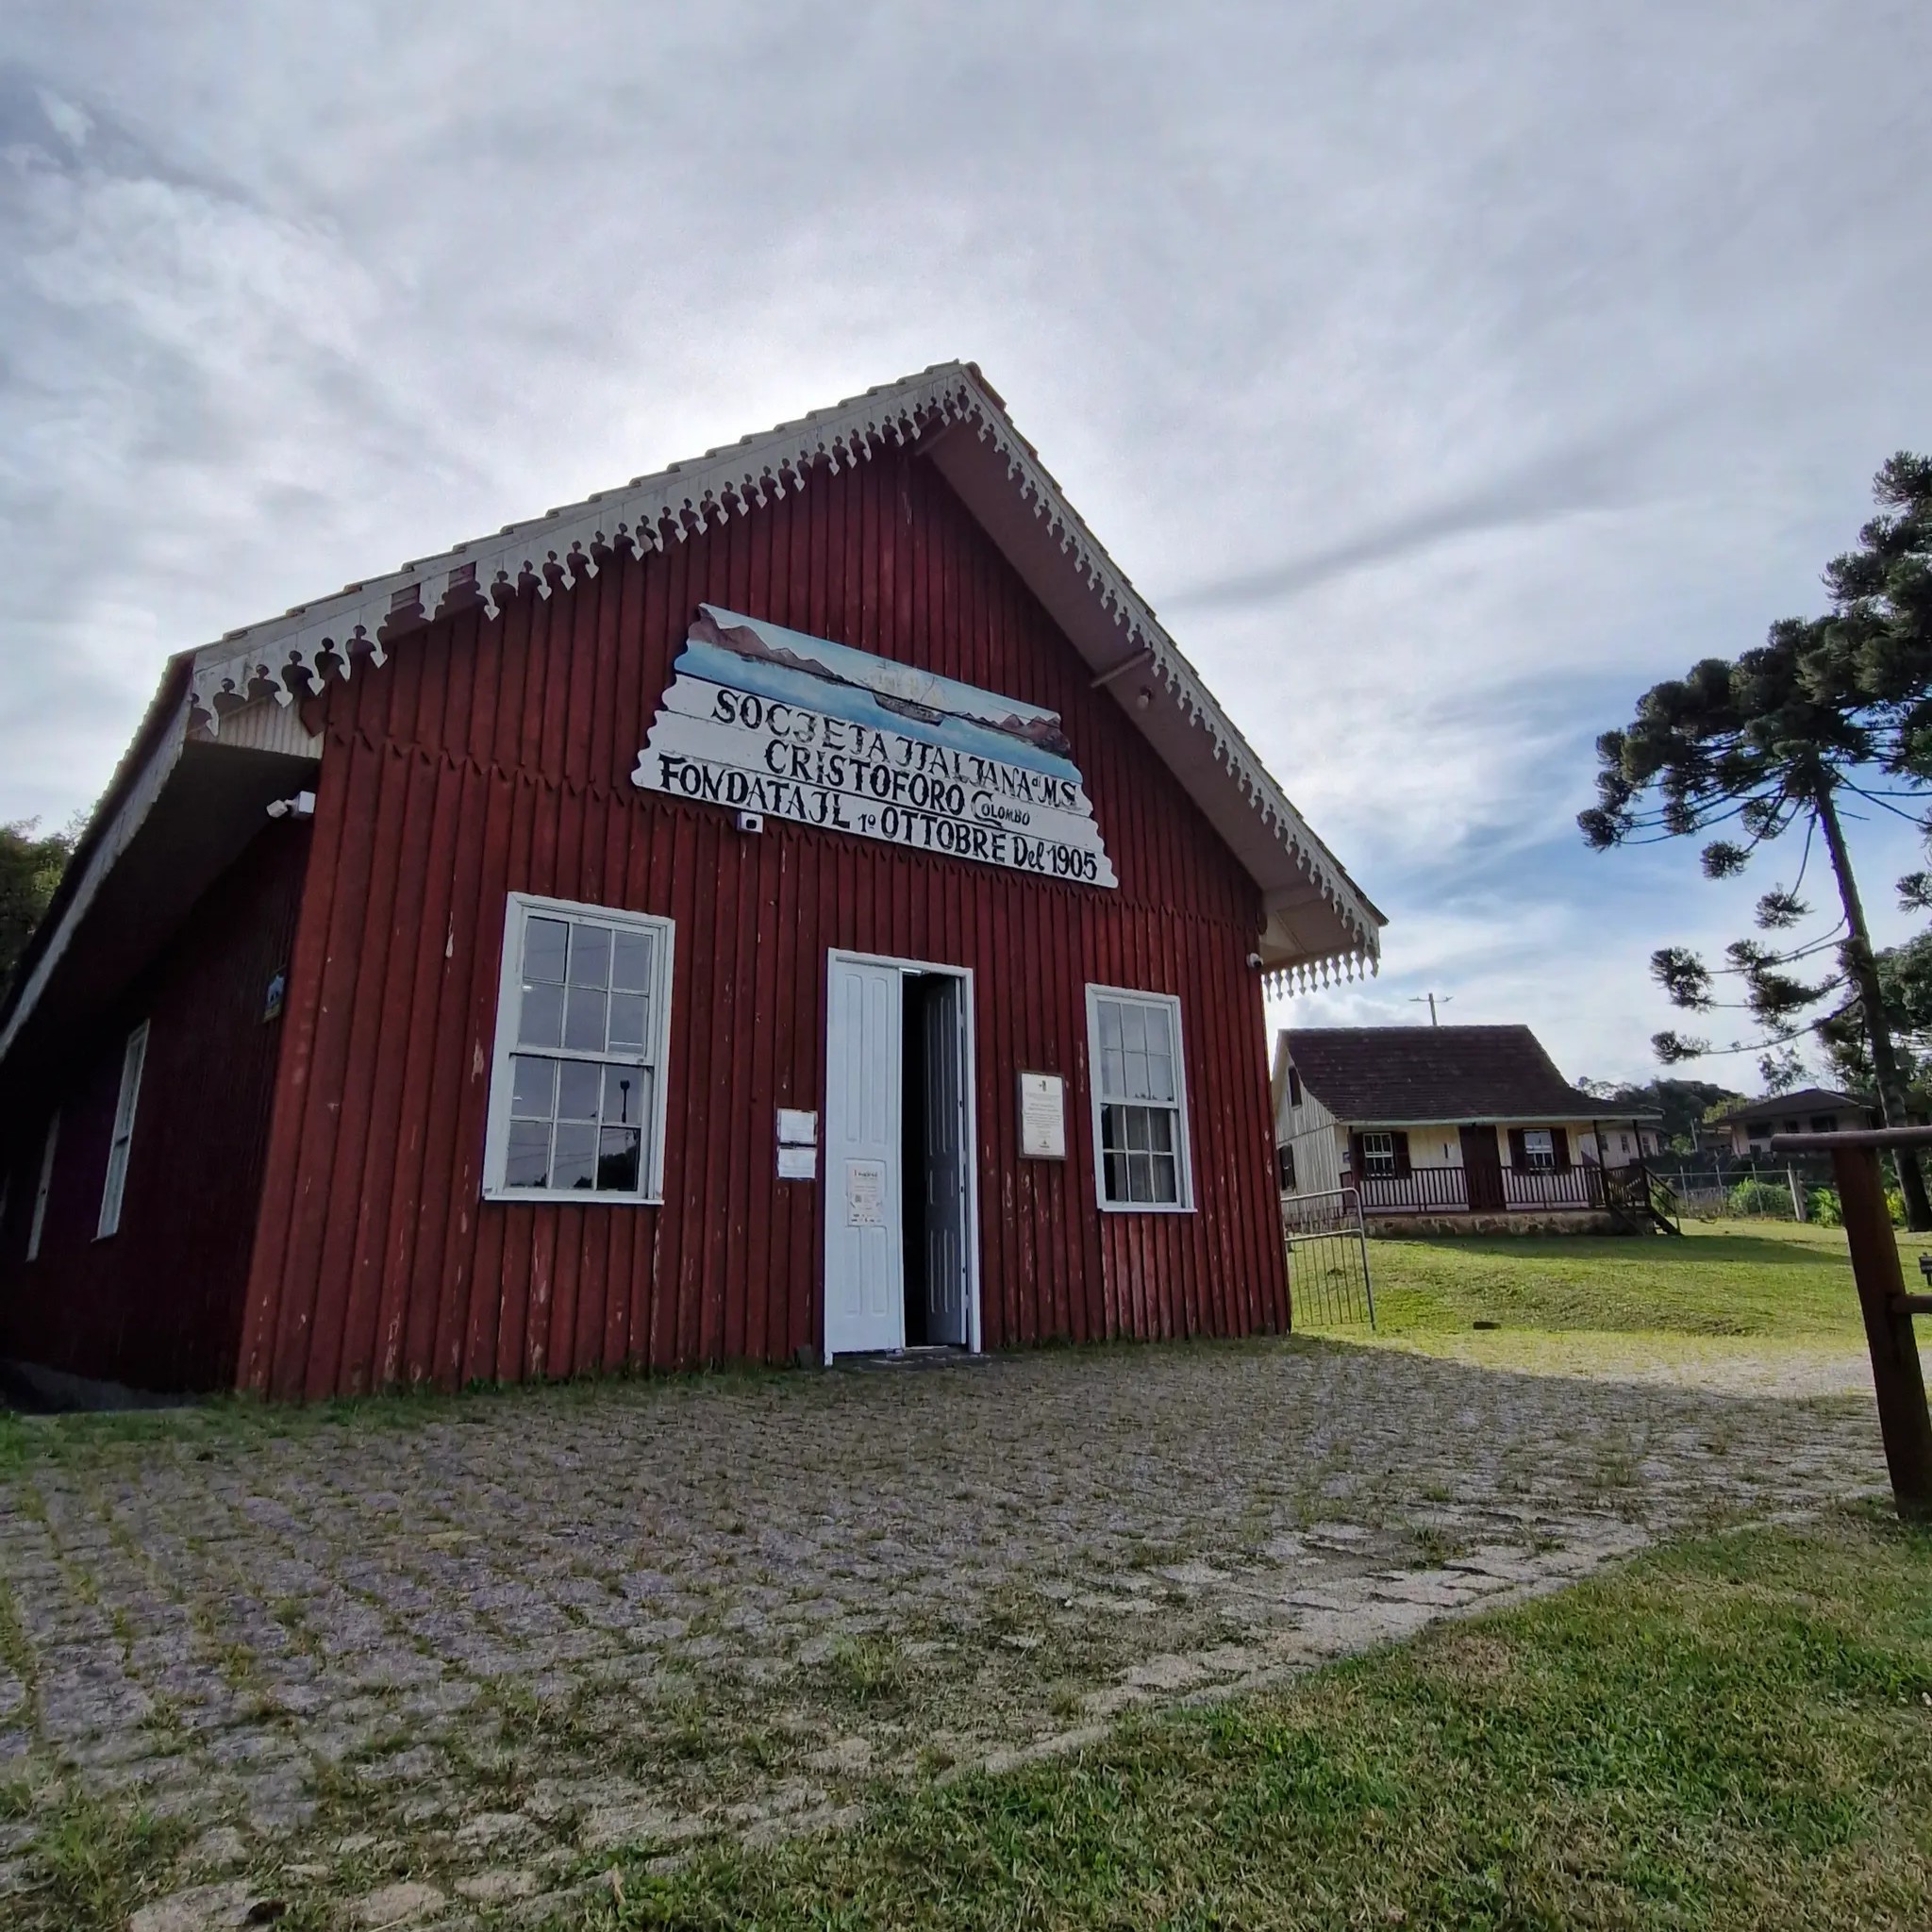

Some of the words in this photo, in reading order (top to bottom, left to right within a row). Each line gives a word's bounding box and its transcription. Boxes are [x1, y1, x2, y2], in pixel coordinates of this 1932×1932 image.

[658, 752, 808, 821] FONDATA
[880, 806, 1007, 863] OTTOBRE
[1011, 836, 1045, 872] Del
[1046, 844, 1098, 881] 1905
[764, 739, 966, 816] CRISTOFORO
